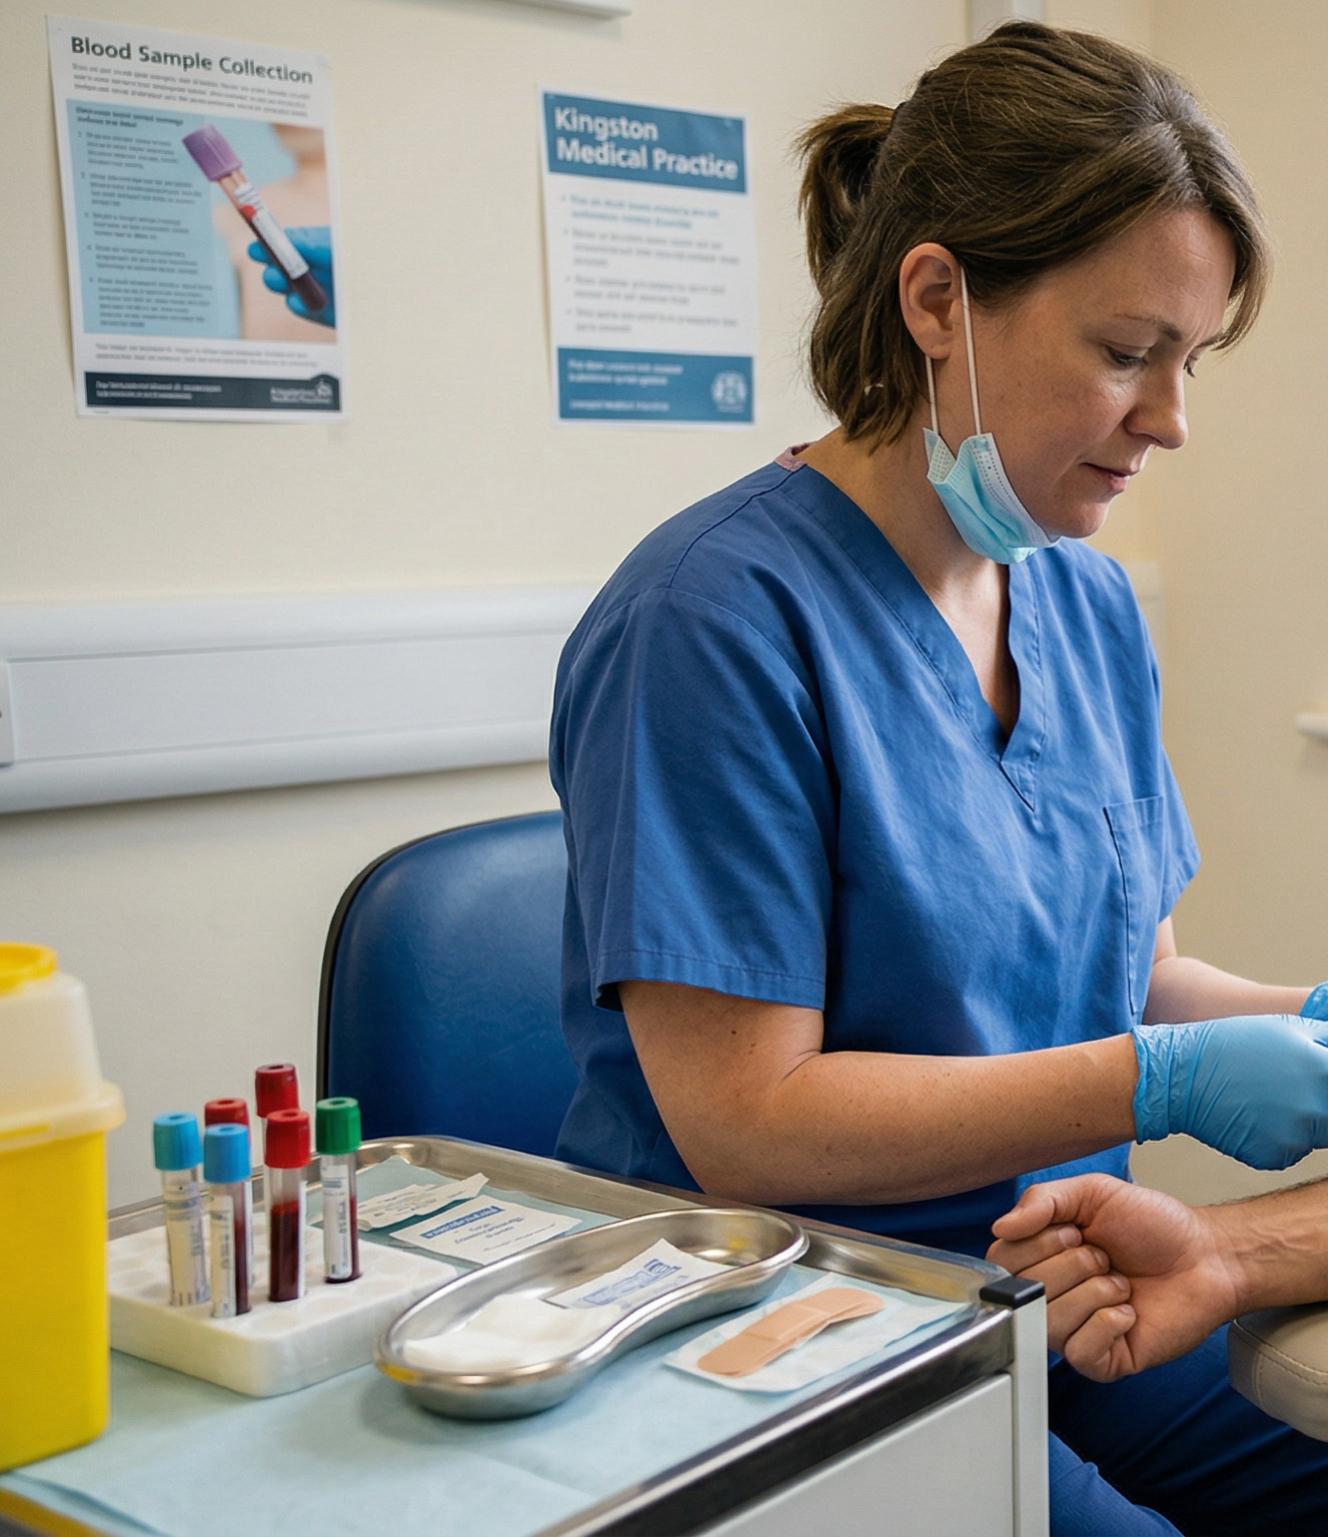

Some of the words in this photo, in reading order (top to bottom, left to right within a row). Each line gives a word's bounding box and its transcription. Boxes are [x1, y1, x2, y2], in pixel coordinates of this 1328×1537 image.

[71, 36, 131, 60] Blood
[139, 45, 213, 71] Sample
[219, 56, 313, 84] Collection
[554, 107, 658, 140] Kingston
[557, 138, 647, 170] Medical
[653, 148, 738, 180] Practice
